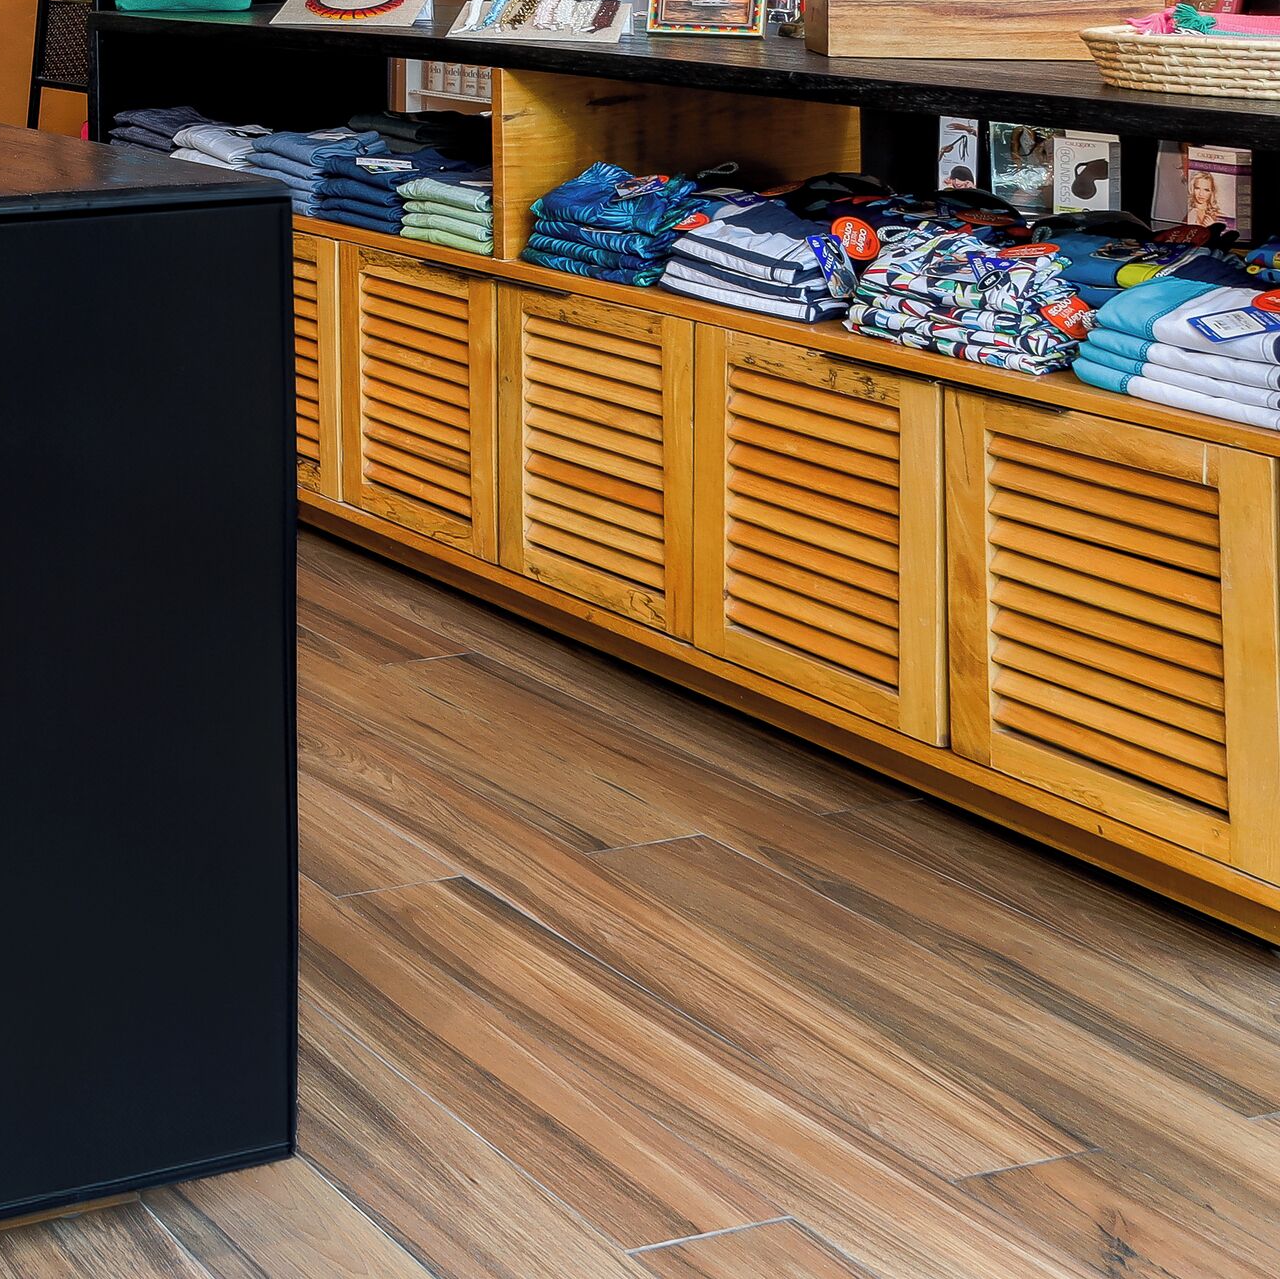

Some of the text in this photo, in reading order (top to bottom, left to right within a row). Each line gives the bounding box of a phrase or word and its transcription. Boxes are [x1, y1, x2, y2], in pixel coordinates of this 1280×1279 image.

[1059, 148, 1071, 203] BOUNDLESS
[842, 222, 853, 247] SECADO
[1047, 298, 1072, 317] SECADO
